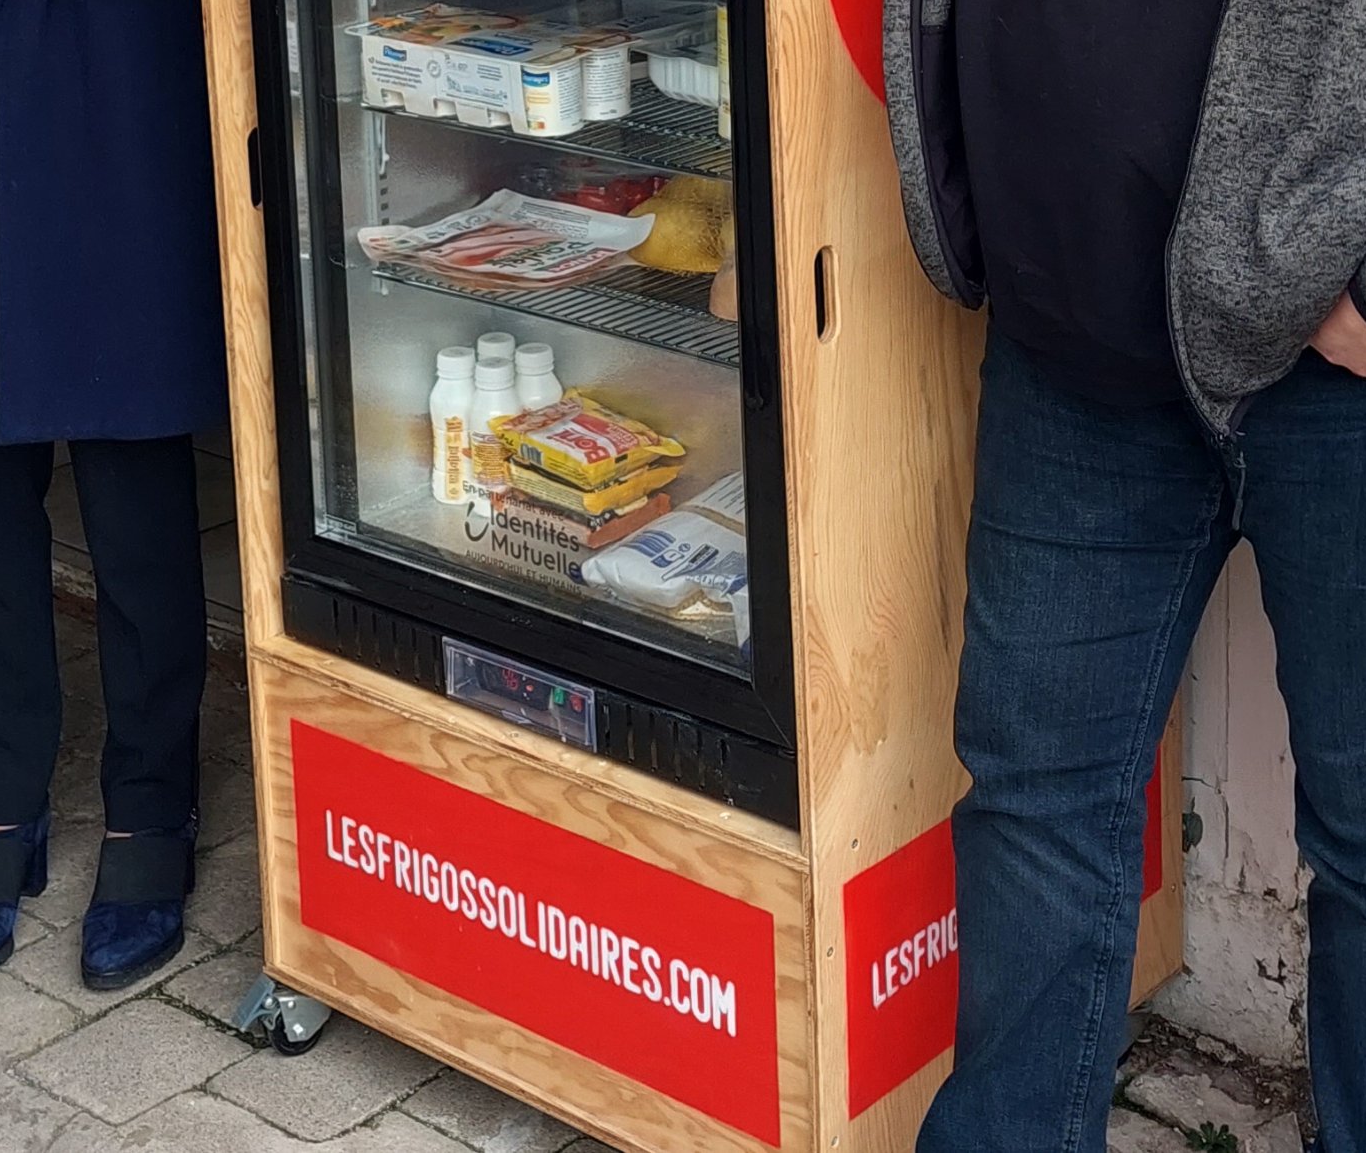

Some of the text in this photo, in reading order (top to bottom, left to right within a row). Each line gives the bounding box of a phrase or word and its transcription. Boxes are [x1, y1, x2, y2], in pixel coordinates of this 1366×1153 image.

[462, 480, 477, 494] En
[539, 507, 565, 522] avec
[490, 503, 581, 552] Identités
[466, 549, 524, 575] AUJOURD'HUI
[526, 569, 538, 579] ET
[491, 530, 582, 579] Mutuelle
[325, 810, 737, 1038] LESFRIGOSSOLIDAIRES.COM
